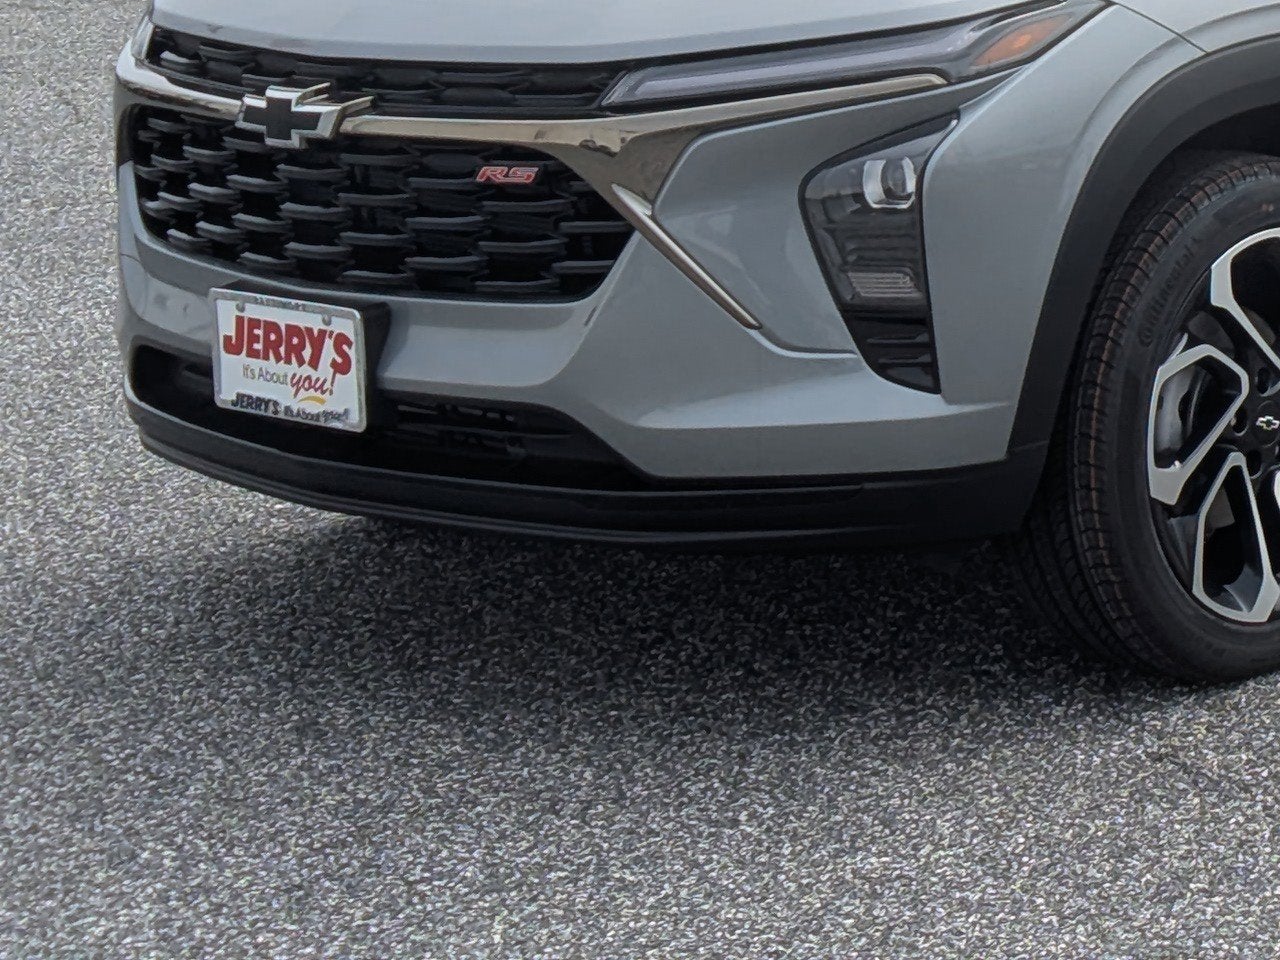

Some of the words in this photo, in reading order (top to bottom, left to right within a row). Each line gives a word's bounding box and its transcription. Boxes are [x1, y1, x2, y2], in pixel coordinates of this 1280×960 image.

[475, 166, 539, 184] RS
[223, 314, 354, 376] JERRY'S
[243, 363, 257, 380] It's
[258, 366, 288, 386] About
[290, 369, 337, 399] you!
